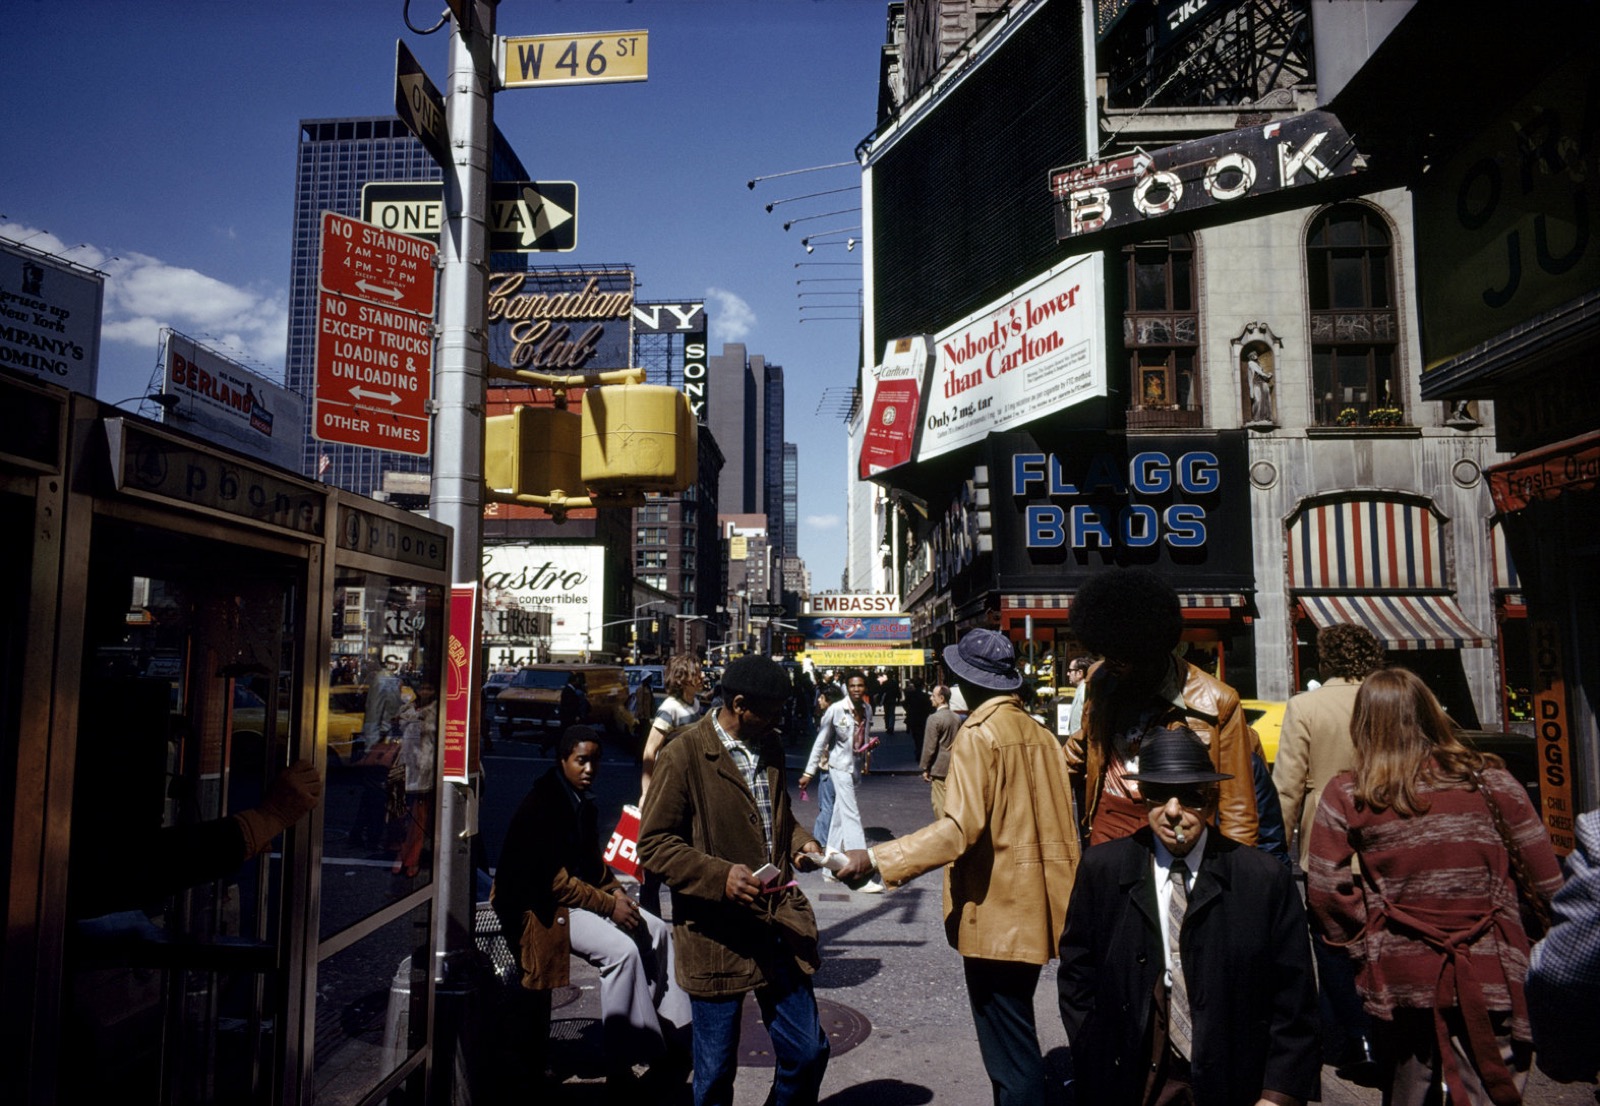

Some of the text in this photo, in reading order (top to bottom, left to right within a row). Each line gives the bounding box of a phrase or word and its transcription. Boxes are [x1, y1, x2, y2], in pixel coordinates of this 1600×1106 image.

[519, 38, 638, 80] W 46 ST
[412, 84, 440, 137] ONE
[1070, 131, 1335, 235] BOOK
[382, 204, 440, 229] ONE
[331, 219, 430, 261] NO STANDING
[345, 242, 353, 253] 7
[355, 246, 371, 258] AM
[386, 253, 398, 265] 10
[401, 259, 417, 271] AM
[343, 256, 350, 268] 4
[356, 261, 372, 273] PM
[388, 267, 395, 279] 7
[399, 272, 415, 284] PM
[354, 271, 406, 288] EXCEPT SUNDAY
[0, 288, 70, 321] pruce up
[488, 272, 632, 320] Canadian
[32, 312, 65, 334] York
[326, 298, 427, 336] NO STANDING
[633, 303, 704, 330] NY
[943, 308, 1022, 373] Nobody's
[1025, 284, 1080, 329] lower
[322, 318, 429, 356] EXCEPT TRUCKS
[510, 319, 604, 368] Club
[335, 341, 416, 373] LOADING &
[881, 366, 909, 378] Carlton
[944, 367, 983, 400] than
[985, 330, 1064, 379] Carlton.
[172, 350, 251, 414] BERLAND
[332, 361, 418, 392] UNLOADING
[684, 343, 706, 416] SONY
[323, 413, 421, 442] OTHER TIMES
[928, 409, 952, 430] Only
[952, 406, 958, 420] 2
[978, 396, 994, 411] tar
[1012, 451, 1221, 496] FLAGG
[1506, 462, 1553, 496] Fresh
[186, 462, 313, 524] phone
[369, 525, 438, 559] phone
[1025, 504, 1207, 548] BROS
[519, 593, 588, 605] convertibles
[813, 597, 896, 611] EMBASSY
[1536, 628, 1557, 690] HOT
[1541, 700, 1564, 786] DOGS
[1550, 833, 1572, 849] KRAUT
